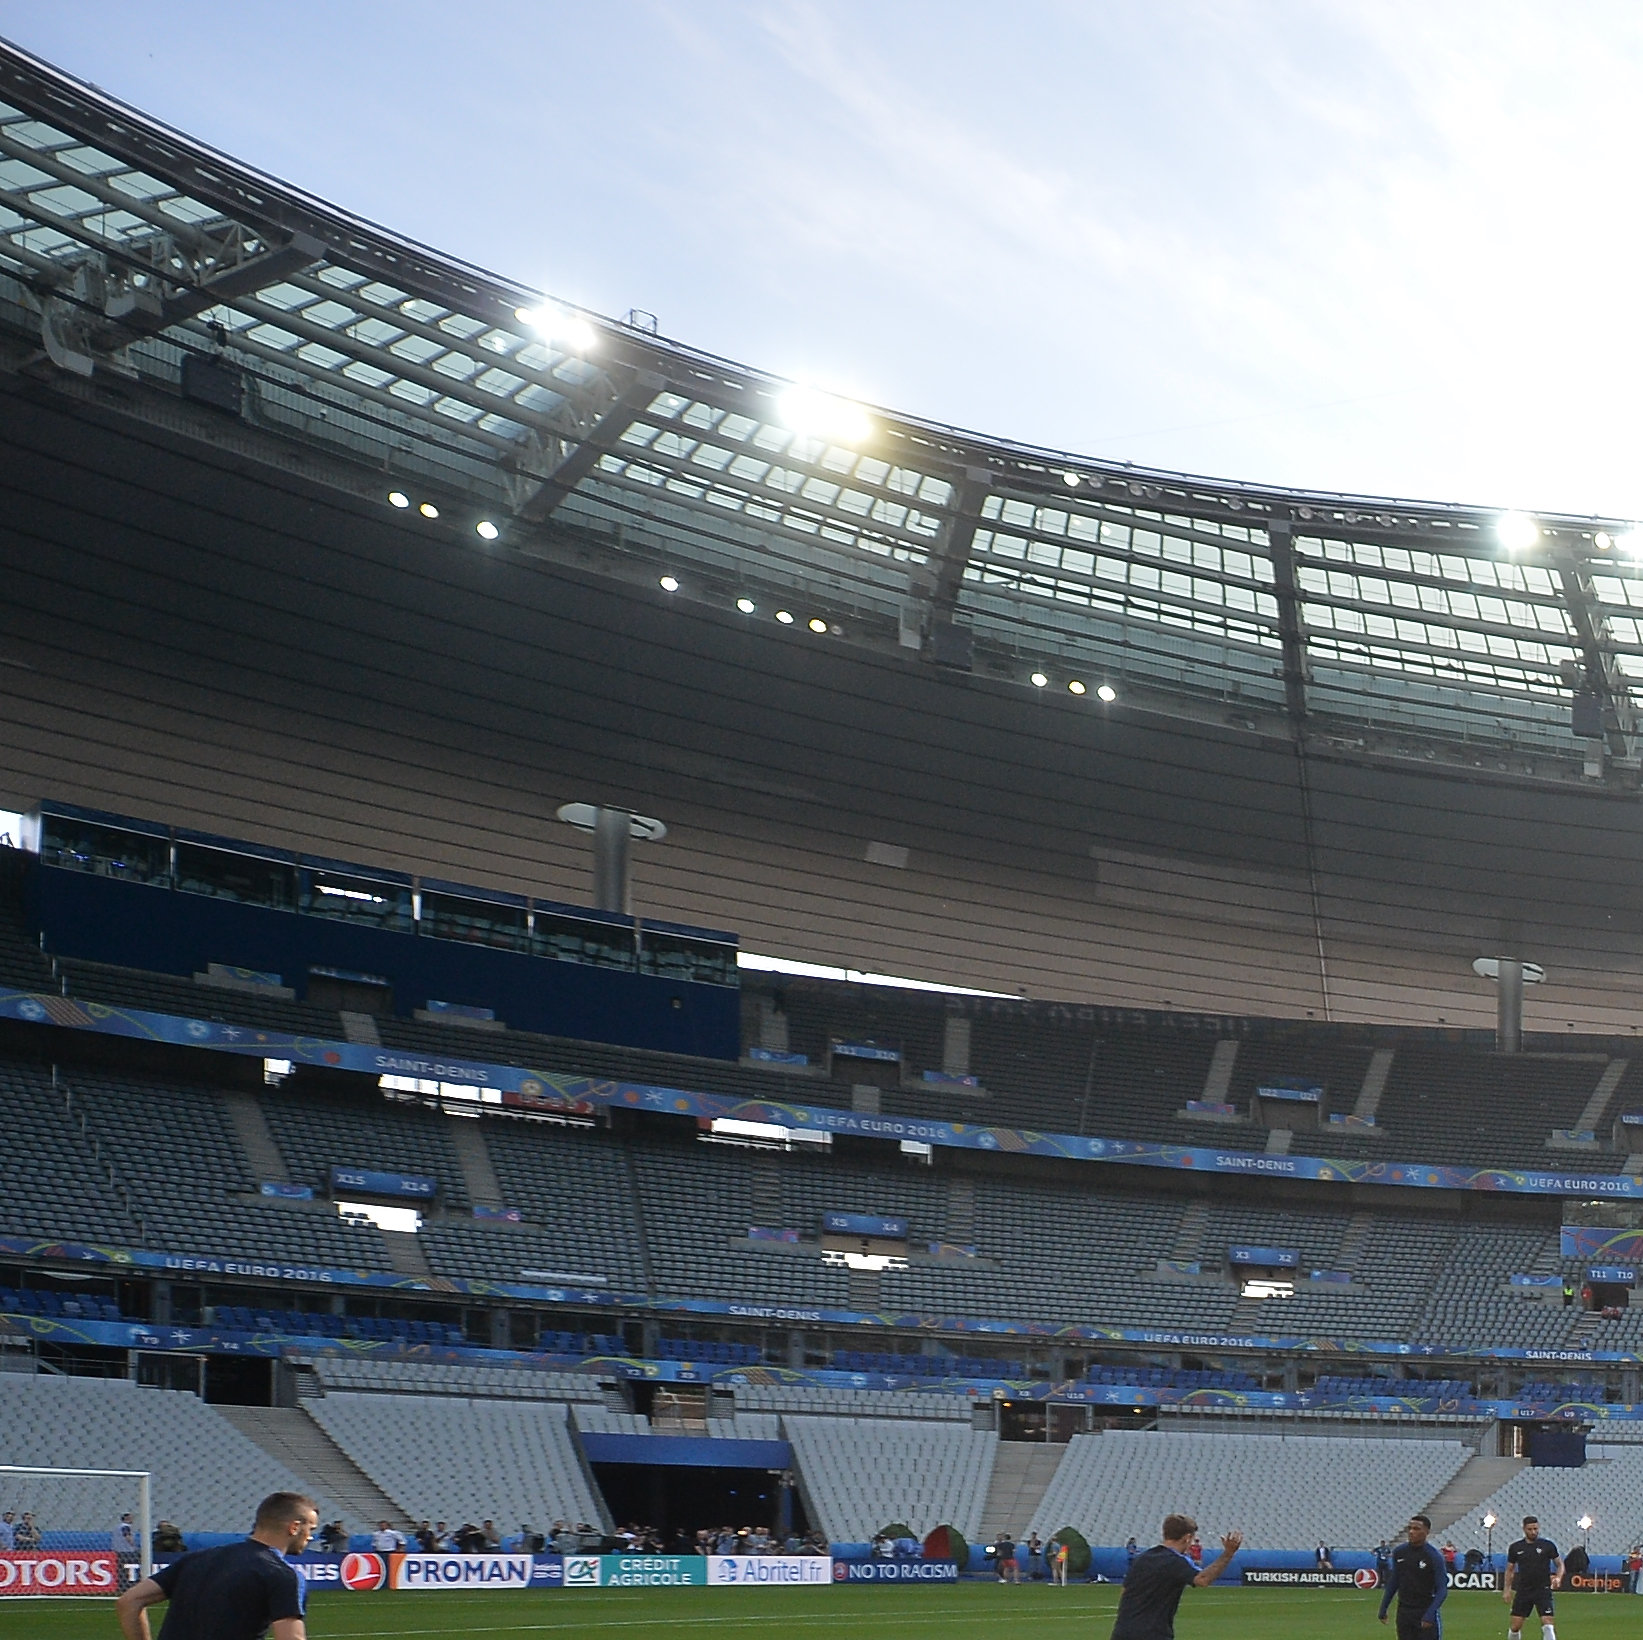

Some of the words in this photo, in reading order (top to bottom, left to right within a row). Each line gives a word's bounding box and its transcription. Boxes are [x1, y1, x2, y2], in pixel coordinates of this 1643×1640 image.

[374, 1055, 489, 1082] SAINT-DENIS
[814, 1115, 857, 1129] UEFA
[861, 1119, 902, 1134] EURO
[907, 1125, 947, 1139] 2016
[1215, 1155, 1296, 1172] SAINT-DENIS
[1529, 1177, 1562, 1189] UEFA
[1564, 1179, 1597, 1191] EURO
[1600, 1181, 1630, 1192] 2016
[1236, 1251, 1250, 1260] X3
[1278, 1254, 1292, 1263] X2
[164, 1256, 220, 1273] UEFA
[224, 1262, 280, 1279] EURO
[282, 1269, 334, 1284] 2016
[1590, 1270, 1607, 1279] T11
[1617, 1271, 1634, 1280] T10
[728, 1305, 821, 1321] SAINT-DENIS
[1144, 1333, 1180, 1344] UEFA
[1182, 1334, 1218, 1346] EURO
[1220, 1337, 1253, 1348] 2016
[1526, 1350, 1593, 1361] SAINT-DENIS
[1520, 1409, 1535, 1417] U17
[619, 1556, 681, 1571] CRÉDIT
[743, 1559, 823, 1582] Abritel.fr
[405, 1560, 526, 1584] PROMAN
[850, 1565, 875, 1579] NO
[877, 1565, 898, 1579] TO
[901, 1564, 958, 1579] RACISM
[1245, 1571, 1299, 1583] TURKISH
[1300, 1573, 1354, 1585] AIRLINES
[607, 1573, 693, 1587] AGRICOLE
[1571, 1575, 1621, 1590] Orange
